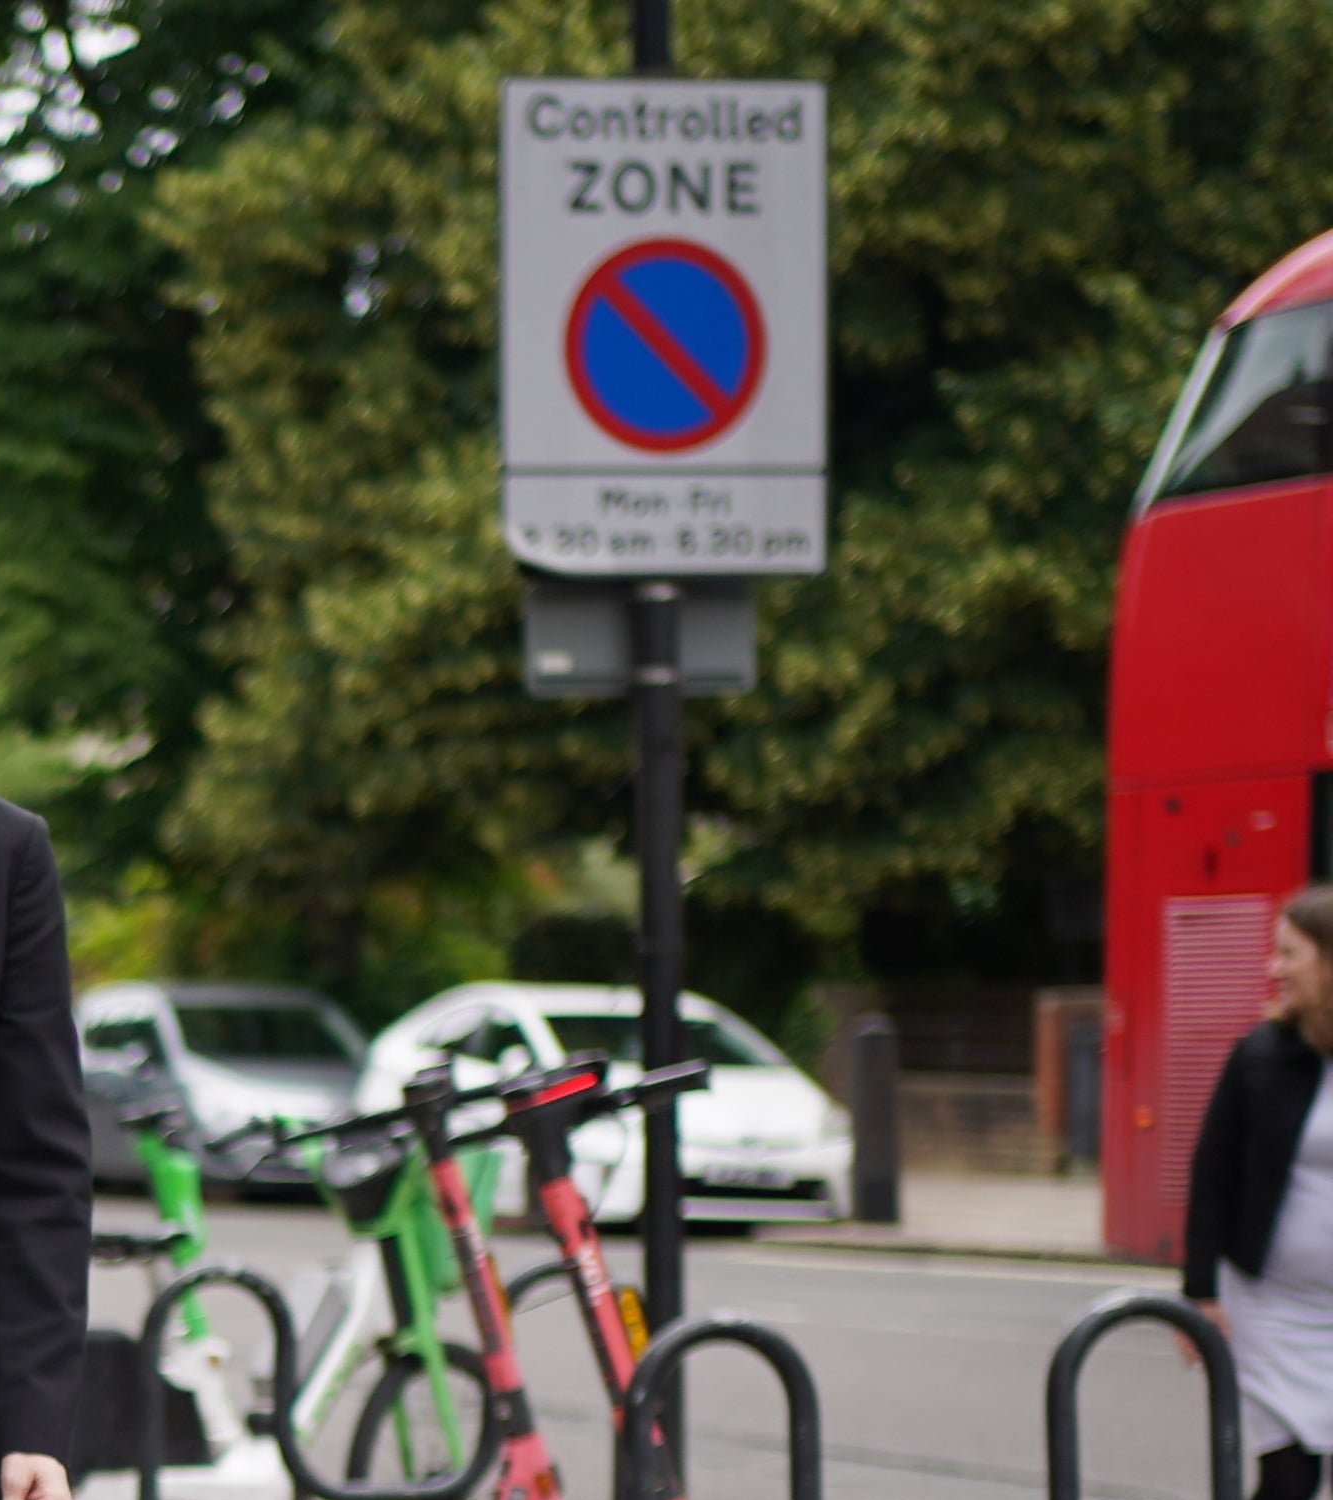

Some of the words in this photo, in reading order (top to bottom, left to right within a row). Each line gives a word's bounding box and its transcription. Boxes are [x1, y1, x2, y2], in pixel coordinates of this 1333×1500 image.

[527, 95, 802, 140] Controlled
[568, 160, 759, 213] ZONE
[599, 487, 669, 516] Mon
[689, 486, 731, 516] Fri
[610, 532, 656, 555] am
[763, 530, 810, 559] pm
